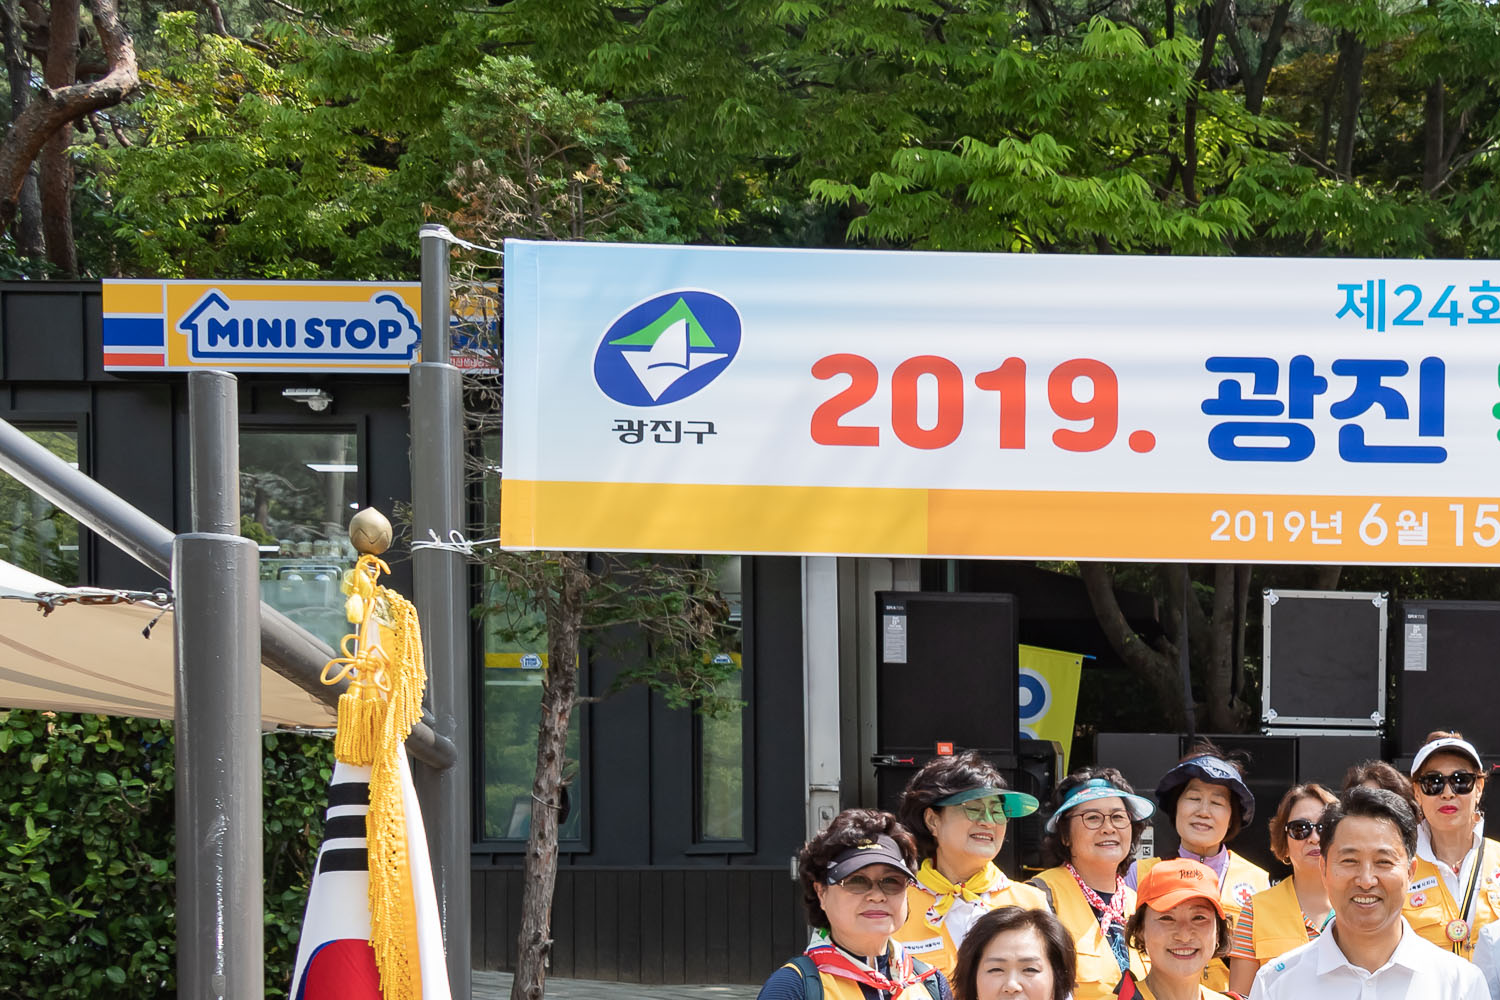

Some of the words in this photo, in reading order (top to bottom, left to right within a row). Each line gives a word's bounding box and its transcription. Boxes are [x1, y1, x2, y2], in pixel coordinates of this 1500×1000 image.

[810, 353, 1156, 453] 2019.
[1201, 355, 1447, 464] 광진
[611, 419, 718, 445] 광진구
[1210, 510, 1343, 545] 2019년
[1358, 503, 1429, 546] 6월
